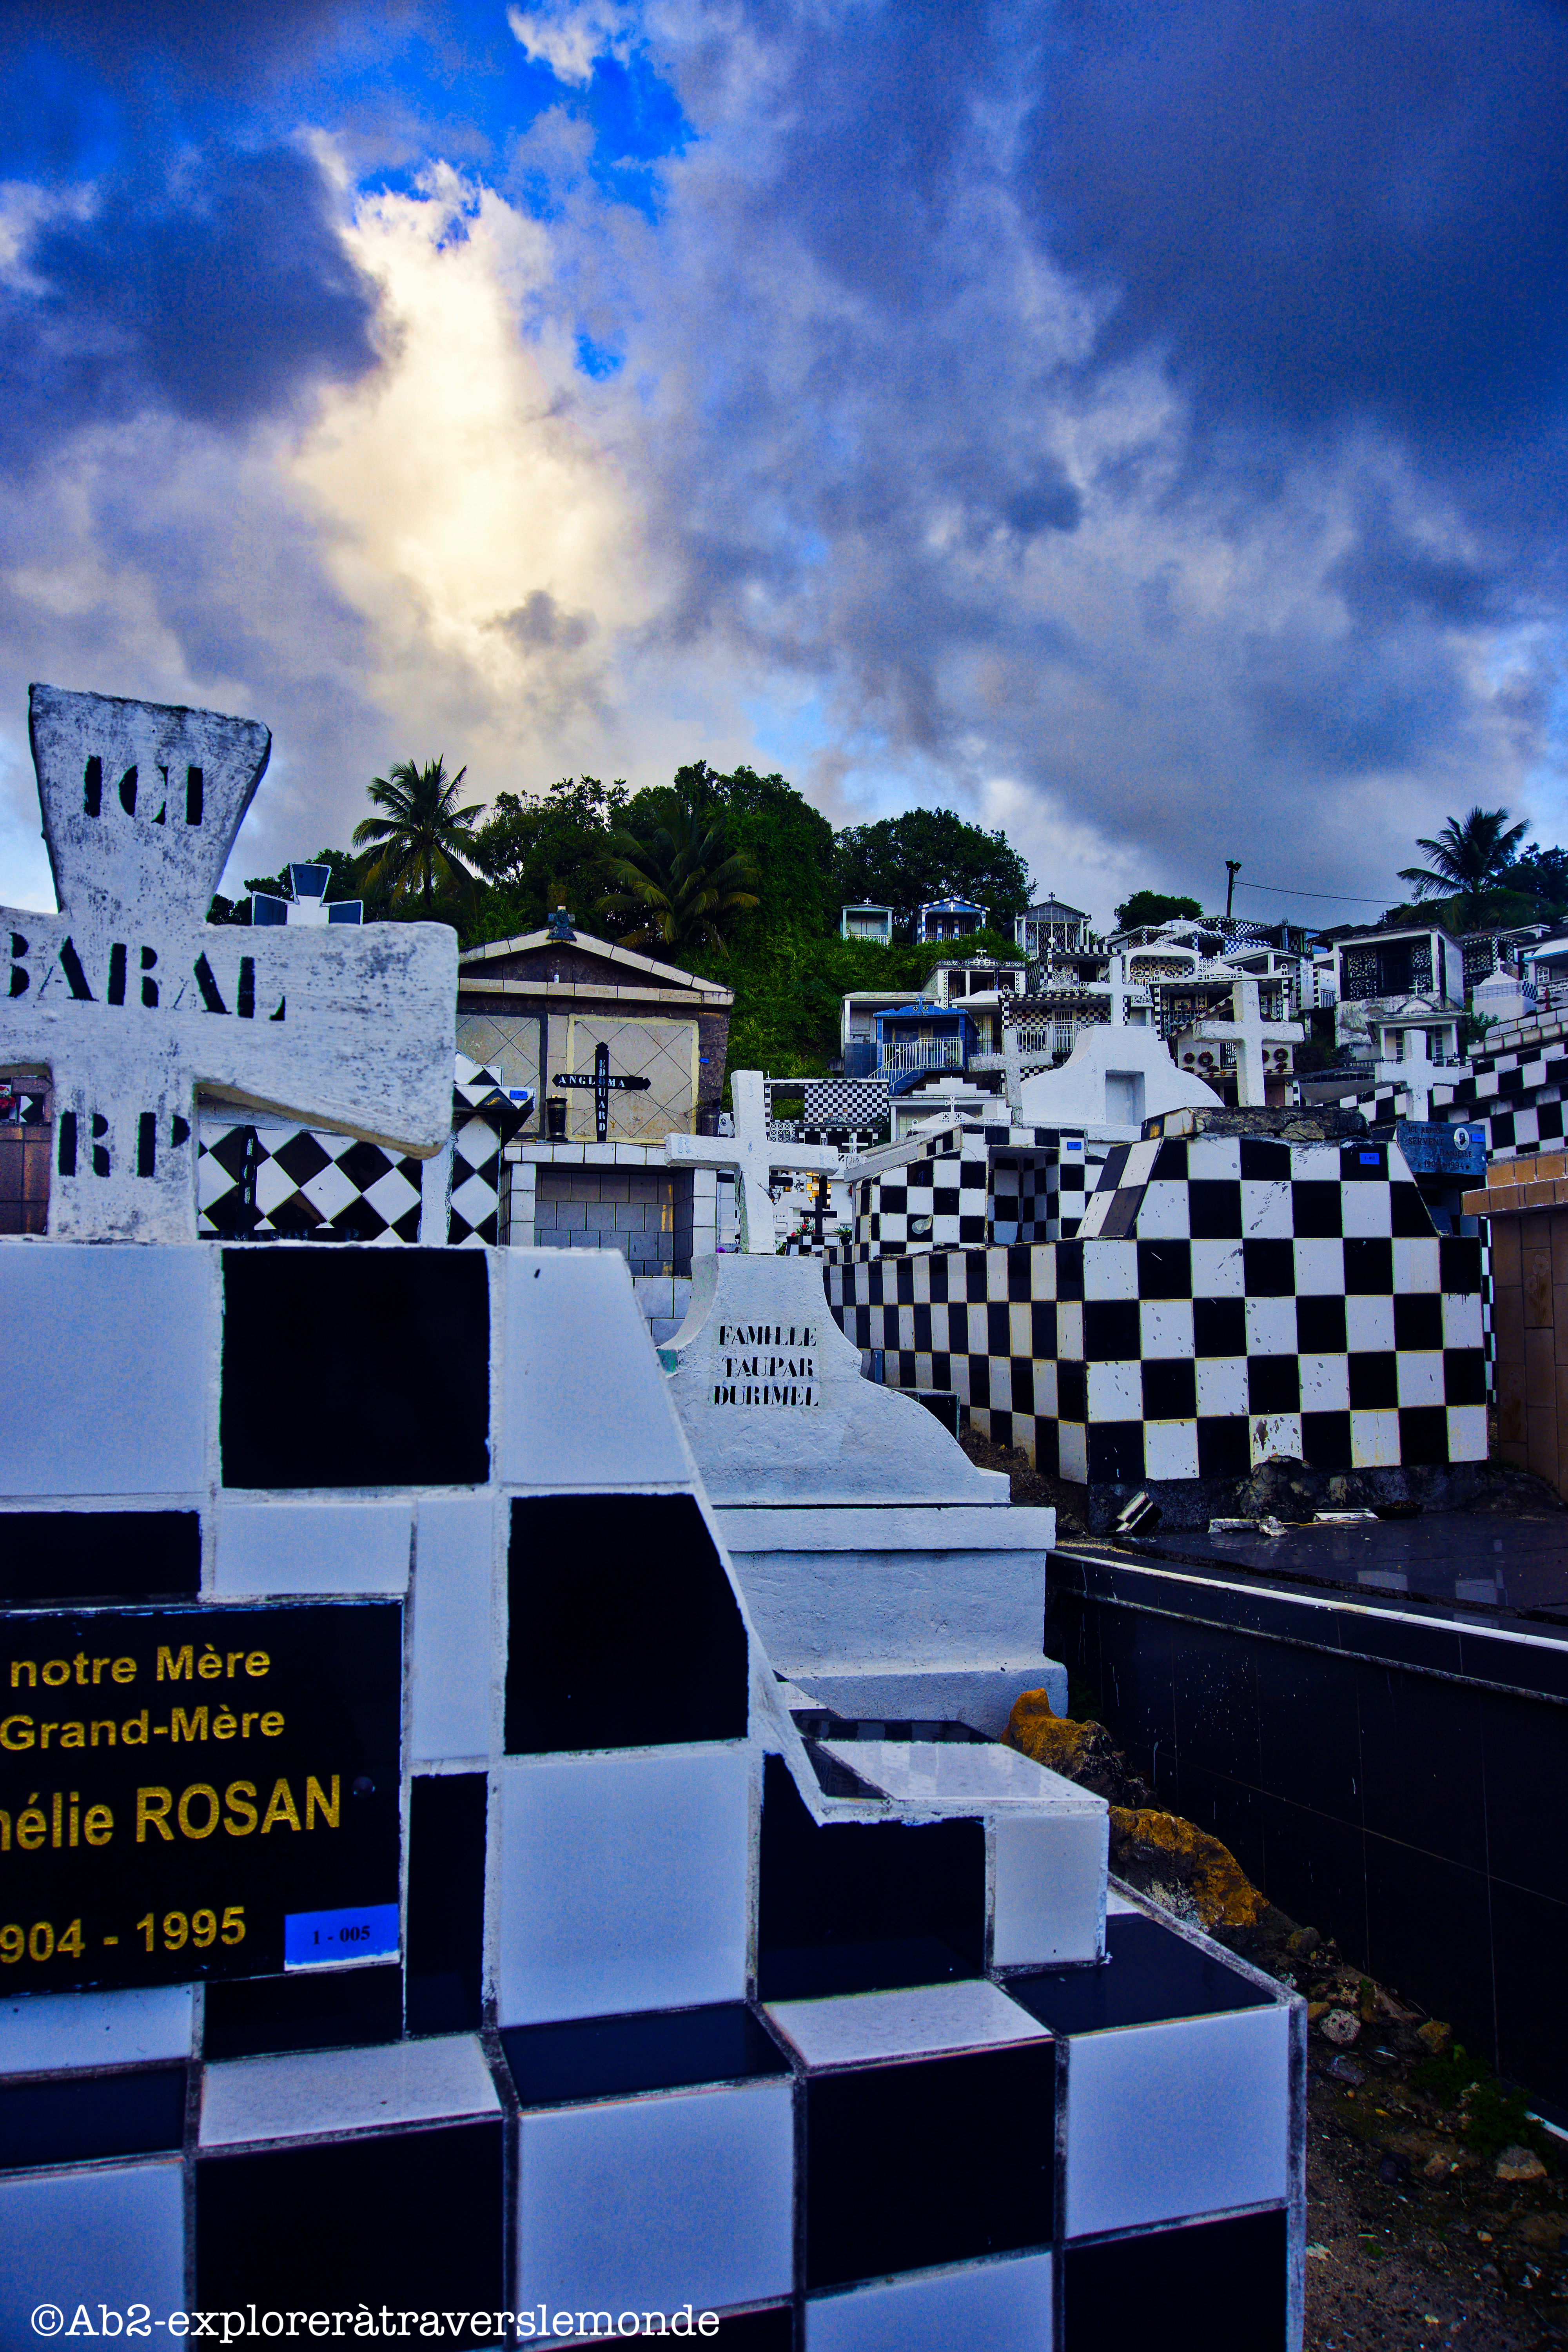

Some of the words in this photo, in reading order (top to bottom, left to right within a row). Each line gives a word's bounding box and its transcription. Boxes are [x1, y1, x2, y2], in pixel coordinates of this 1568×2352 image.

[83, 755, 204, 826] ICI
[1408, 1136, 1445, 1146] SERVENT
[719, 1326, 816, 1347] FAMILLE
[721, 1357, 813, 1377] TAUPAR
[714, 1386, 818, 1406] DURIMEL
[10, 1652, 137, 1688] notre
[156, 1644, 270, 1681] Mère
[0, 1704, 285, 1750] Grand-Mère
[136, 1775, 340, 1842] ROSAN
[137, 1906, 245, 1952] 1995
[339, 1926, 370, 1942] 005
